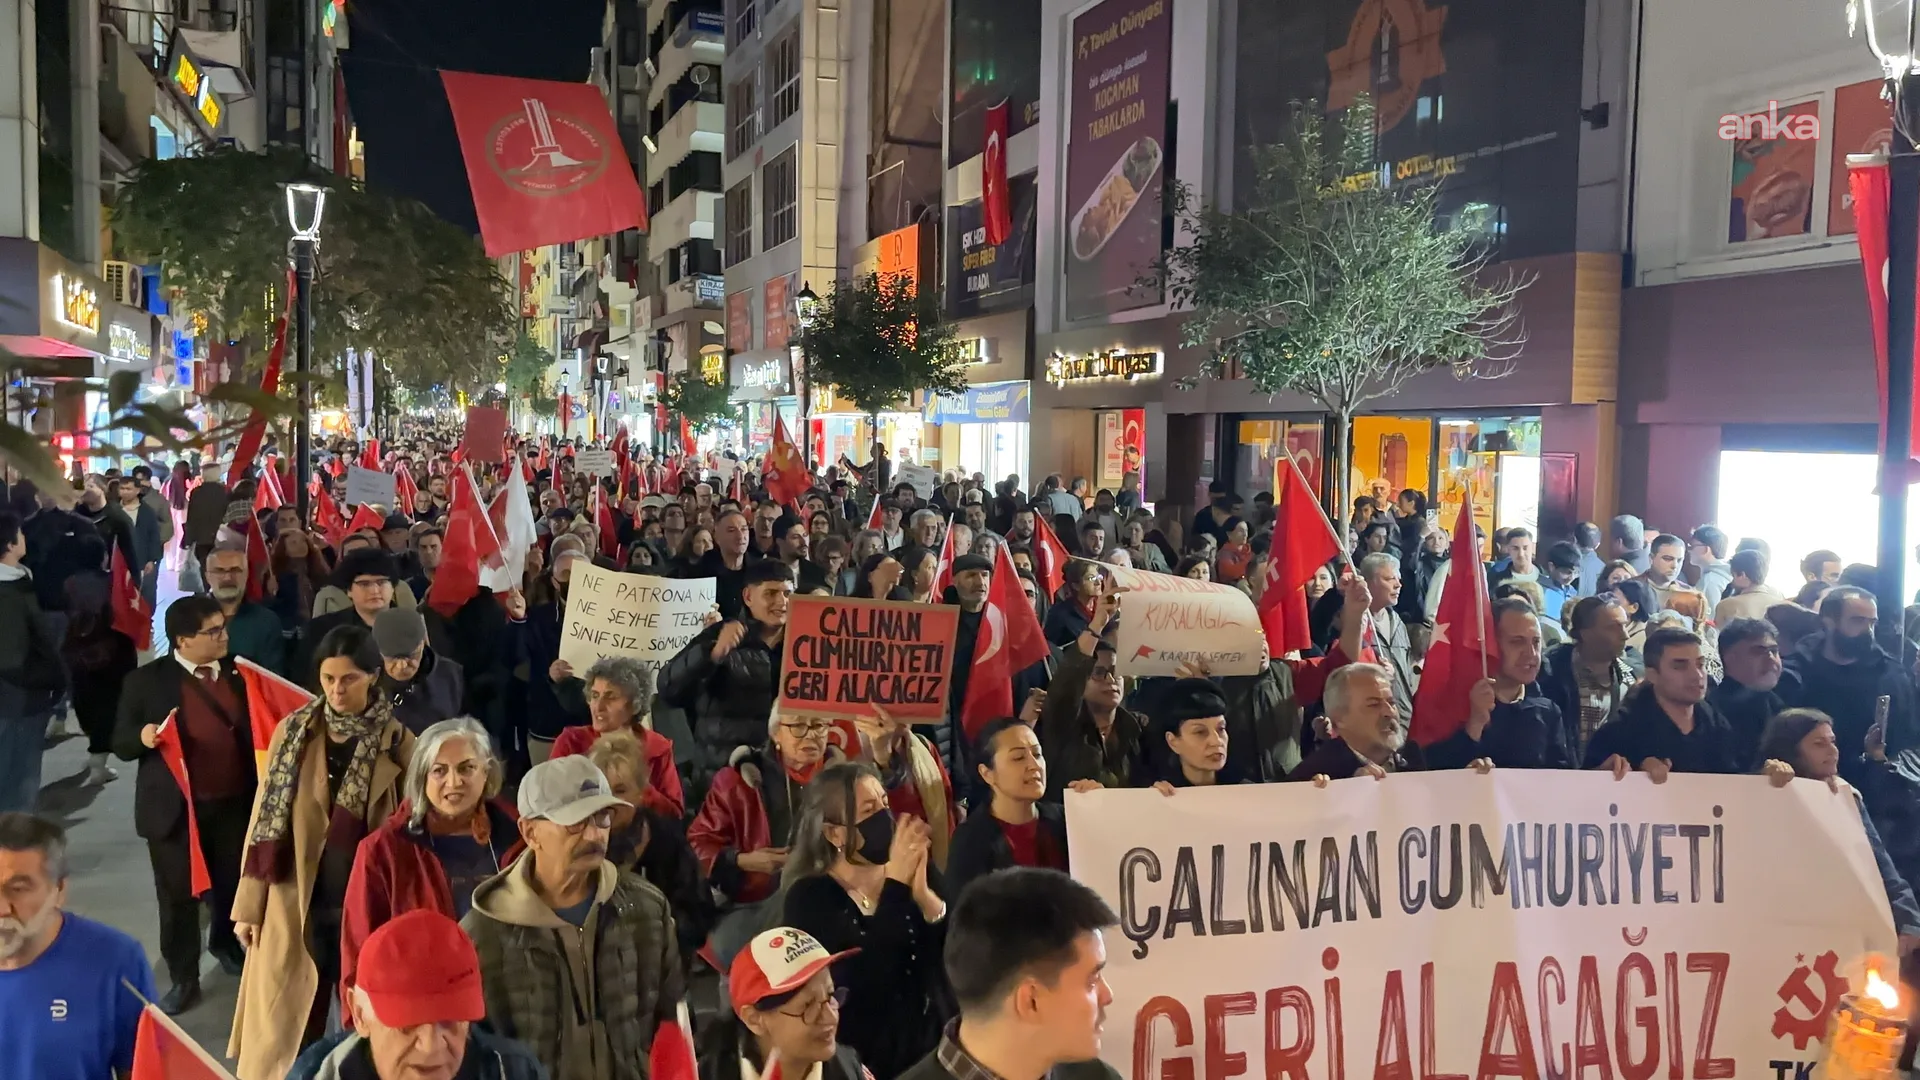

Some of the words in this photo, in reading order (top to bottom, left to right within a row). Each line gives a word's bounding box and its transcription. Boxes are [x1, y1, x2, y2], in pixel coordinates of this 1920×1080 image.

[1090, 22, 1118, 52] Tavuk
[1120, 1, 1163, 36] Dünyası
[1095, 74, 1139, 112] KOCAMAN
[1088, 99, 1145, 141] TABAKLARDA
[967, 272, 990, 293] BURADA
[582, 573, 605, 593] NE
[616, 583, 692, 603] PATRONA
[576, 599, 597, 616] NE
[607, 608, 660, 628] ŞEYHE
[792, 634, 944, 673] CUMHURİYETİ
[784, 671, 829, 701] GERİ
[1119, 830, 1381, 960] ÇALINAN
[1398, 803, 1725, 915] CUMHURİYETİ
[1132, 947, 1344, 1080] GERİ
[1373, 926, 1736, 1080] ALACAĞIZ
